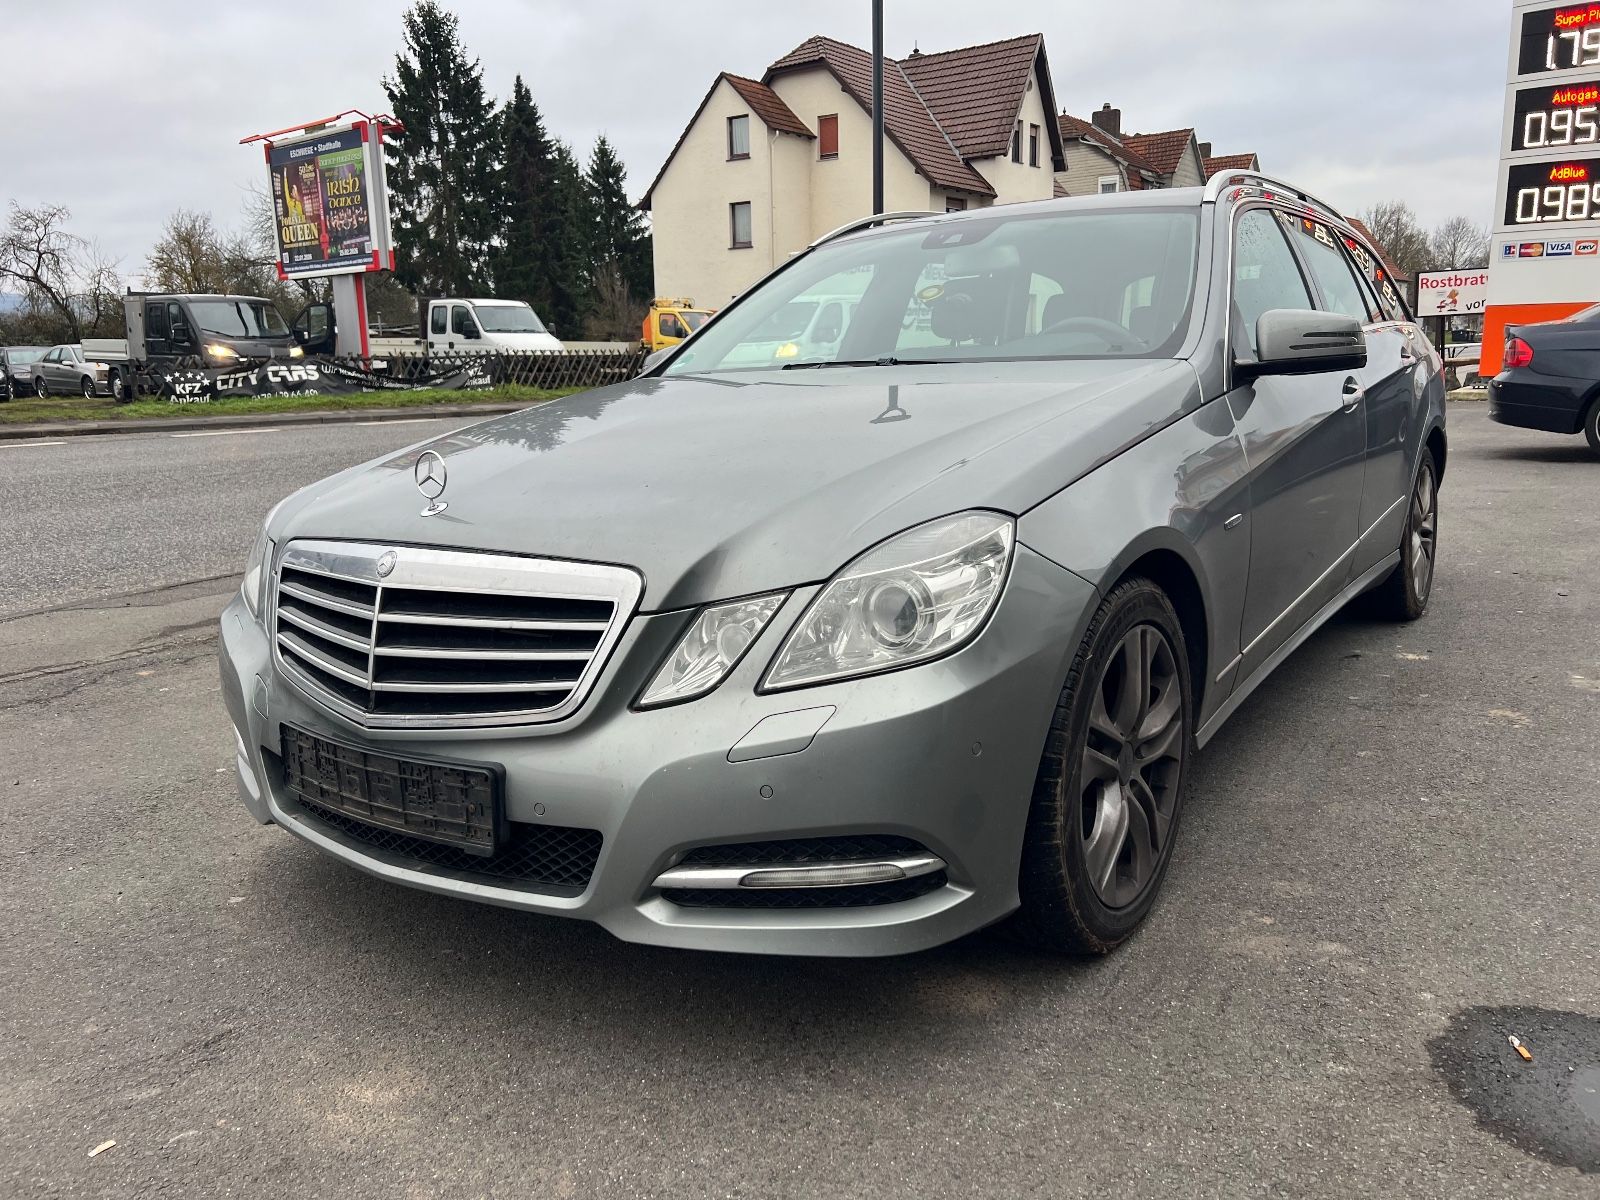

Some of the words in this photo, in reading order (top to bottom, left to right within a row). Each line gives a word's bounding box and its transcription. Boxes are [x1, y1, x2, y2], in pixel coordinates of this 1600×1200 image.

[1555, 14, 1586, 26] Super
[1589, 9, 1600, 21] Pl
[1553, 91, 1598, 103] Autogas
[1524, 106, 1600, 148] 0.95
[289, 146, 313, 158] ESCHWEGE
[317, 141, 342, 152] Stadthalle
[1550, 168, 1585, 179] AdBlue
[282, 222, 319, 244] QUEEN
[1550, 243, 1571, 251] VISA
[267, 365, 319, 383] CARS
[175, 383, 202, 394] KFZ
[170, 393, 211, 404] Ankauf
